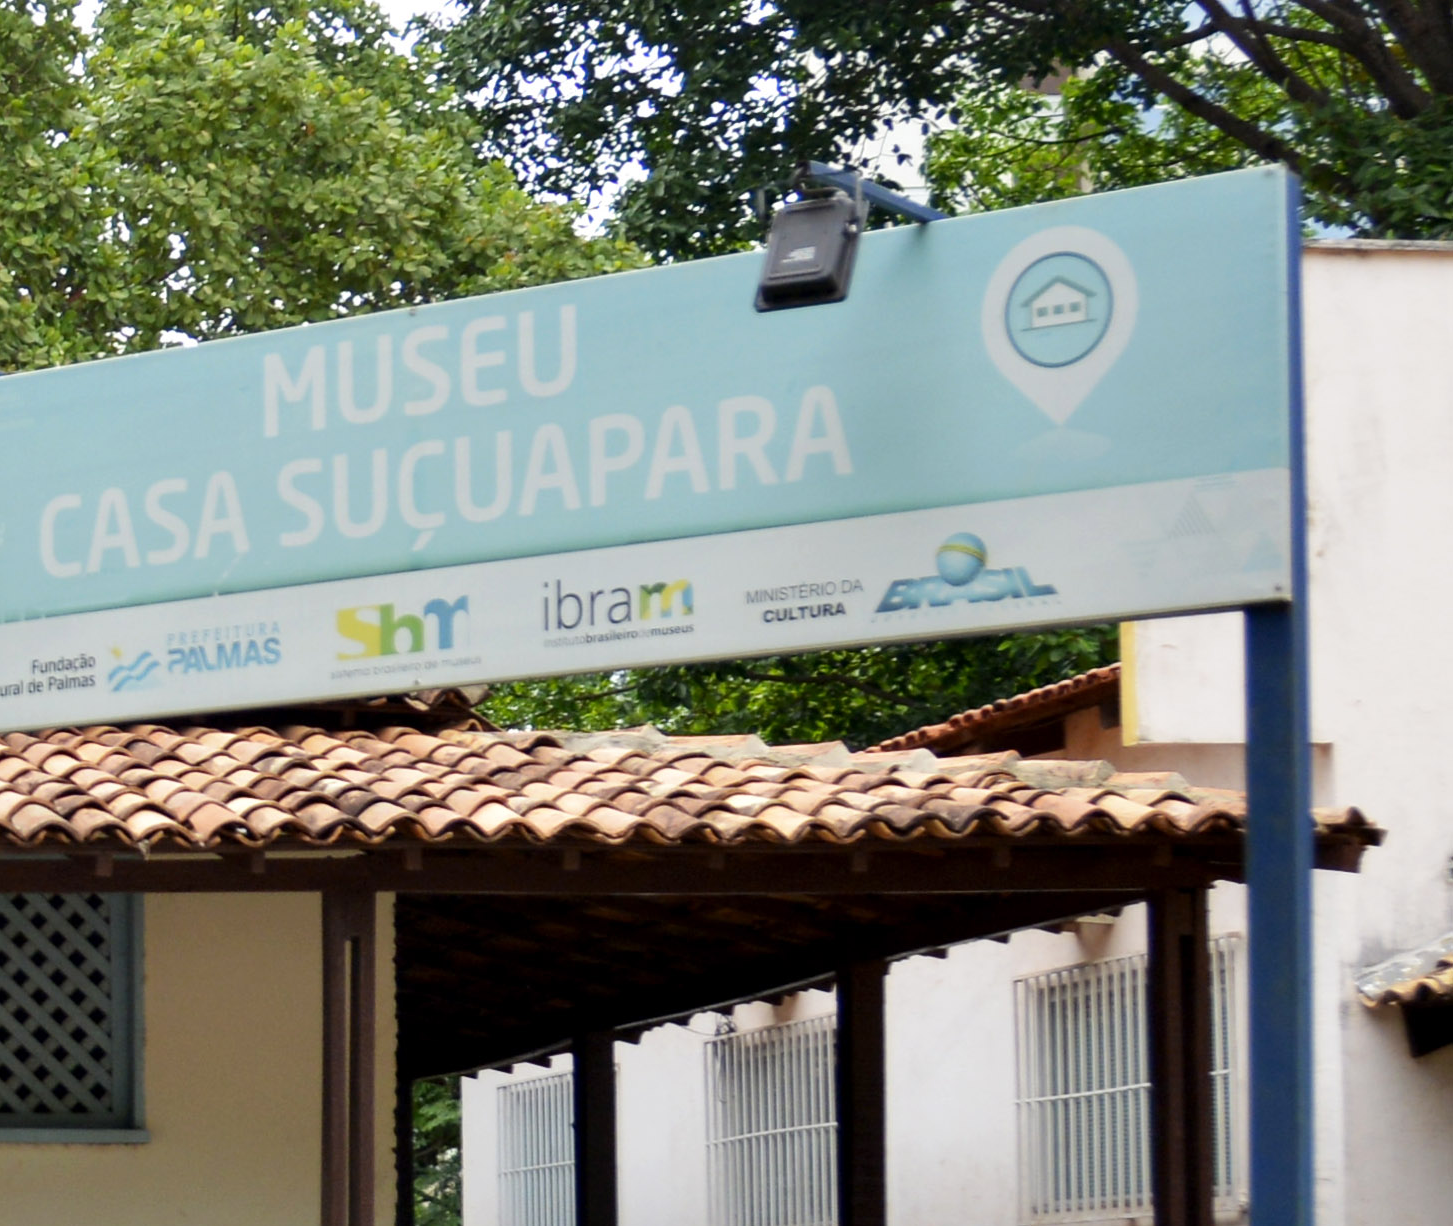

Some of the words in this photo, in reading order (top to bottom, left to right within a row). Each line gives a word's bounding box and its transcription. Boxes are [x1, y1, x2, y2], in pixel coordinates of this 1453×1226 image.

[263, 304, 577, 438] MUSEU
[38, 470, 251, 579] CASA
[276, 384, 854, 552] SUÇUAPARA
[745, 581, 837, 604] MINISTÉRIO
[841, 579, 864, 594] DA
[542, 579, 694, 632] ibram
[762, 602, 847, 623] CULTURA
[166, 620, 282, 646] PREFEITURA
[31, 653, 96, 674] Fundação
[167, 636, 282, 674] PALMAS
[27, 678, 44, 694] de
[48, 675, 96, 691] Palmas
